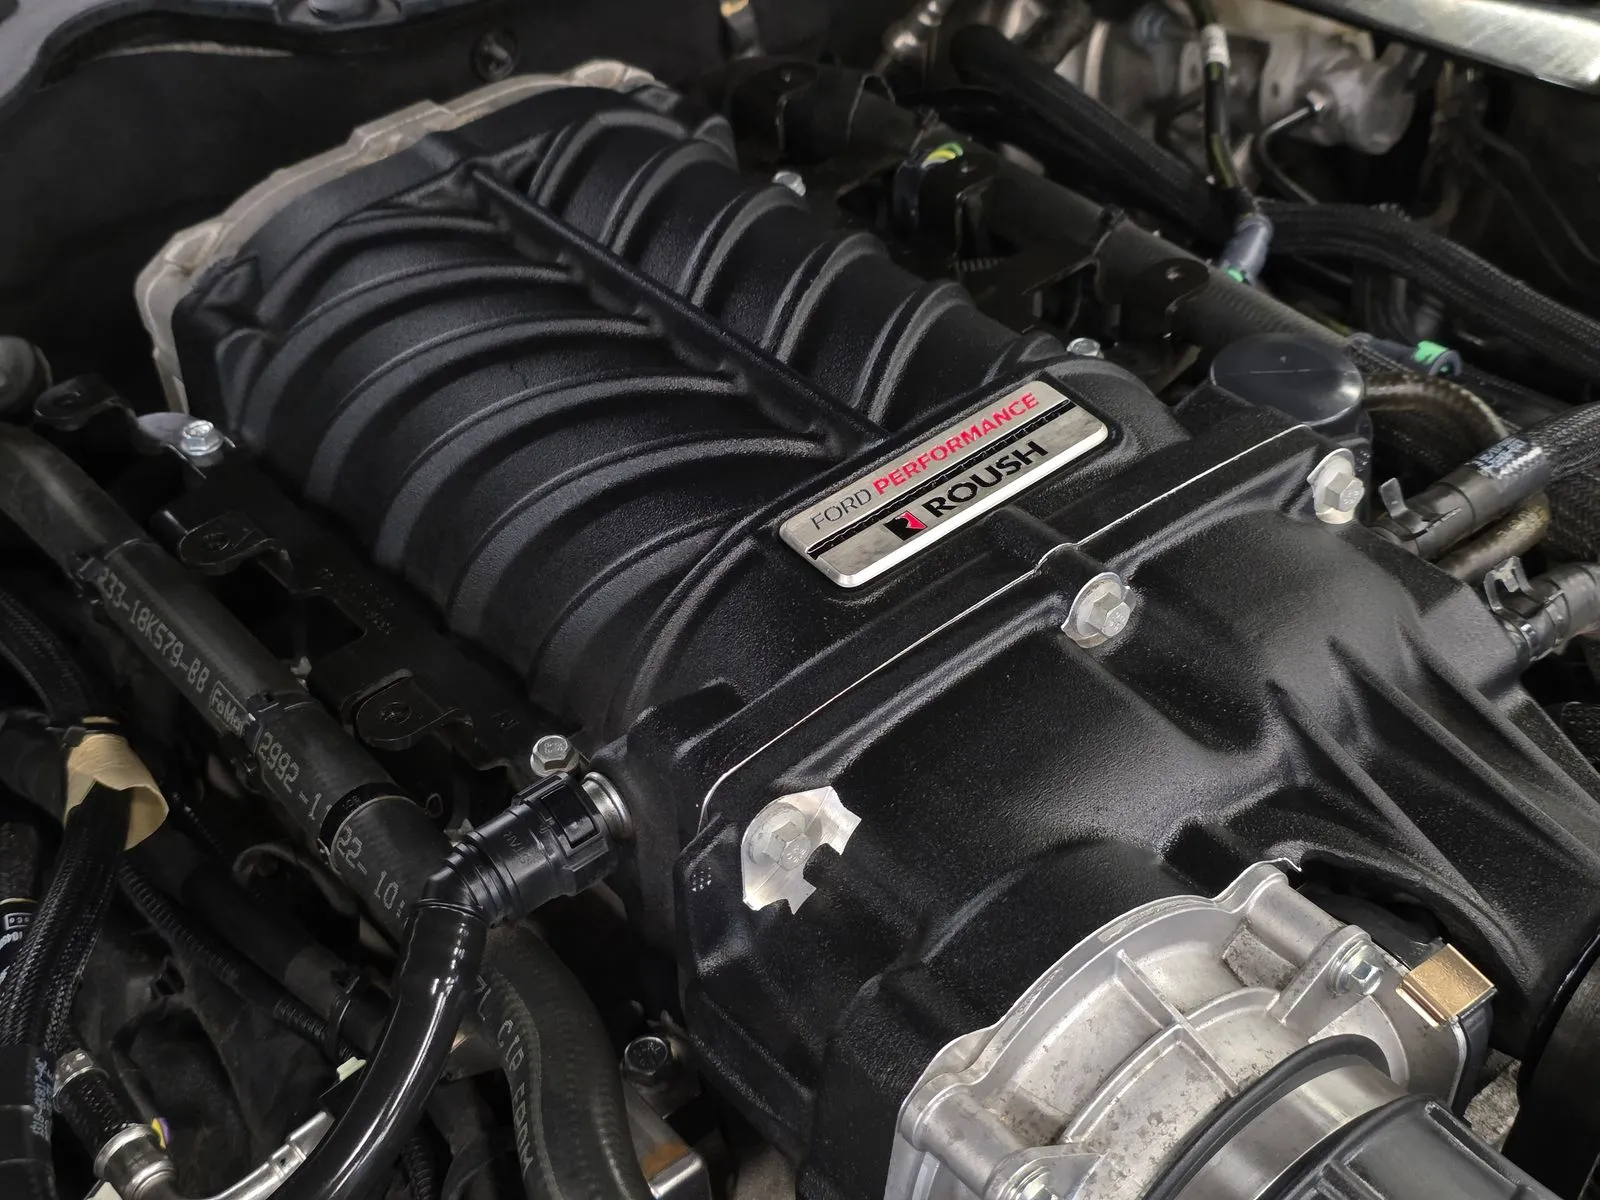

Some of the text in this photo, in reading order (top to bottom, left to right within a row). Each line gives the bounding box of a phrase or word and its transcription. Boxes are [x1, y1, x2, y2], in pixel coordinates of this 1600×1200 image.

[810, 392, 1040, 531] FORD PERFORMANCE
[921, 440, 1049, 518] ROUSH
